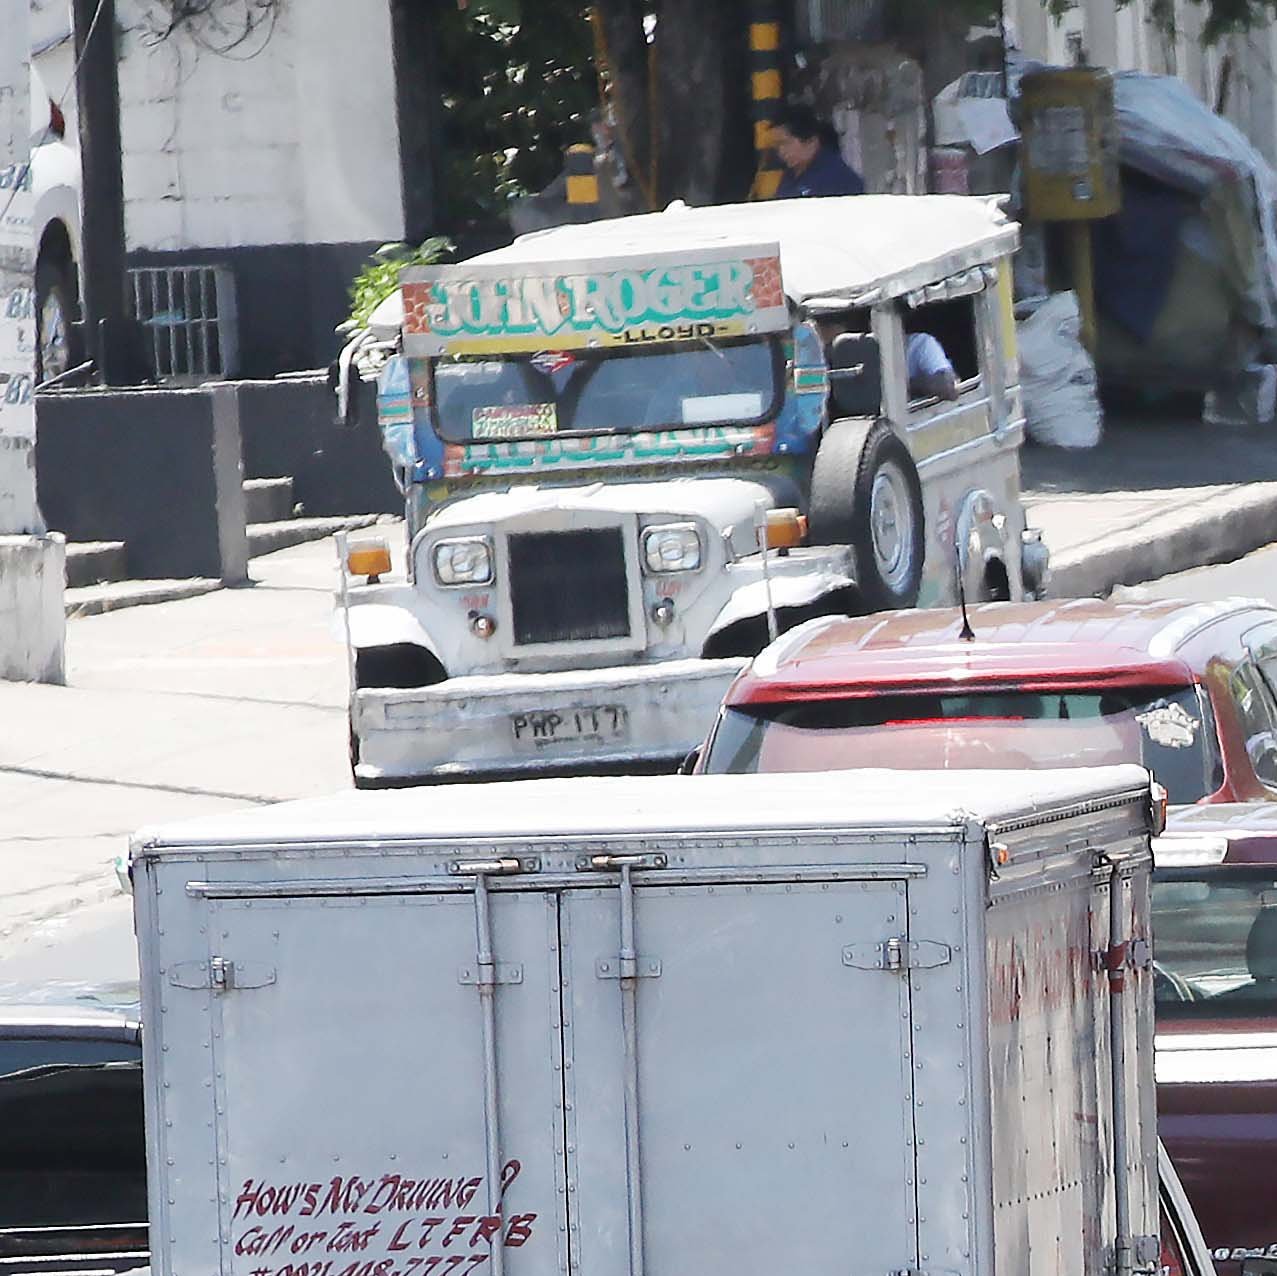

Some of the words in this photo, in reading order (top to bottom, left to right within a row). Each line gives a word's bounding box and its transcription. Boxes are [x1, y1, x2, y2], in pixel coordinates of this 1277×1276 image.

[566, 261, 754, 332] ROGER
[234, 1224, 295, 1257] Call
[290, 1231, 327, 1255] or
[386, 1213, 537, 1251] LTFRB
